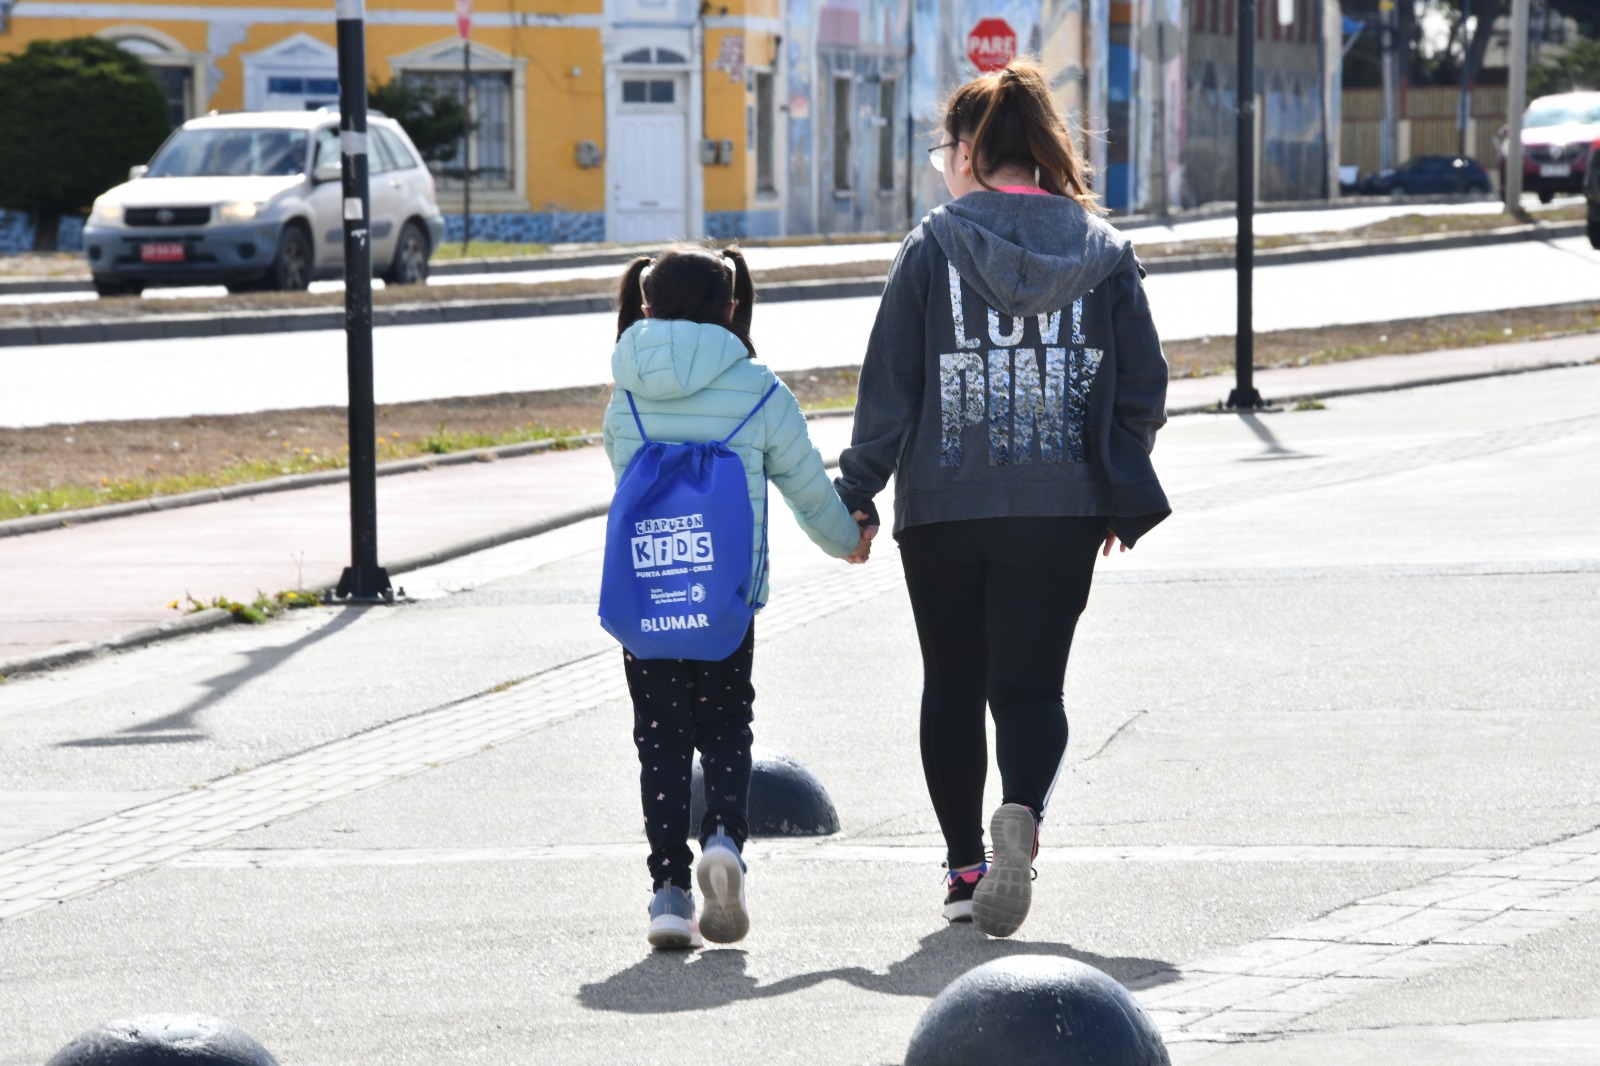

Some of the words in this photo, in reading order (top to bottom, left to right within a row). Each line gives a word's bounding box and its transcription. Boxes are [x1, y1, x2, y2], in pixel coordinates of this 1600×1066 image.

[968, 35, 1013, 55] PARE
[661, 568, 688, 576] ARENAS
[693, 564, 712, 572] CHILE
[641, 614, 709, 632] BLUMAR
